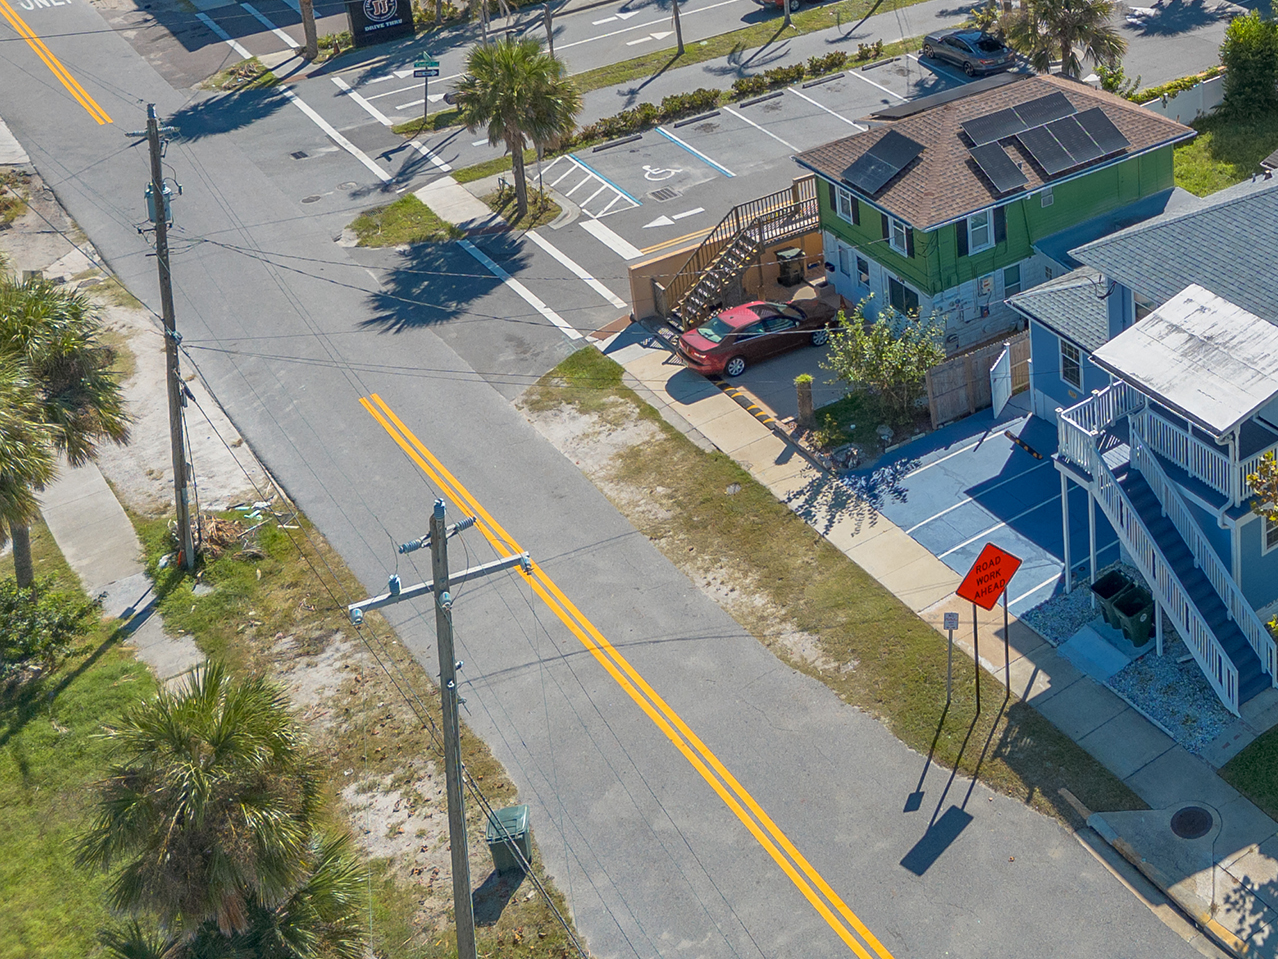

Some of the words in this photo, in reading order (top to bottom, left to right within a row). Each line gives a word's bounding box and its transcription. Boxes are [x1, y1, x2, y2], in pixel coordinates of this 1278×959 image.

[364, 22, 385, 32] DRIVE
[385, 18, 403, 27] THRU
[975, 555, 1002, 575] ROAD
[975, 568, 1002, 587] WORK
[974, 578, 1006, 600] AHEAD
